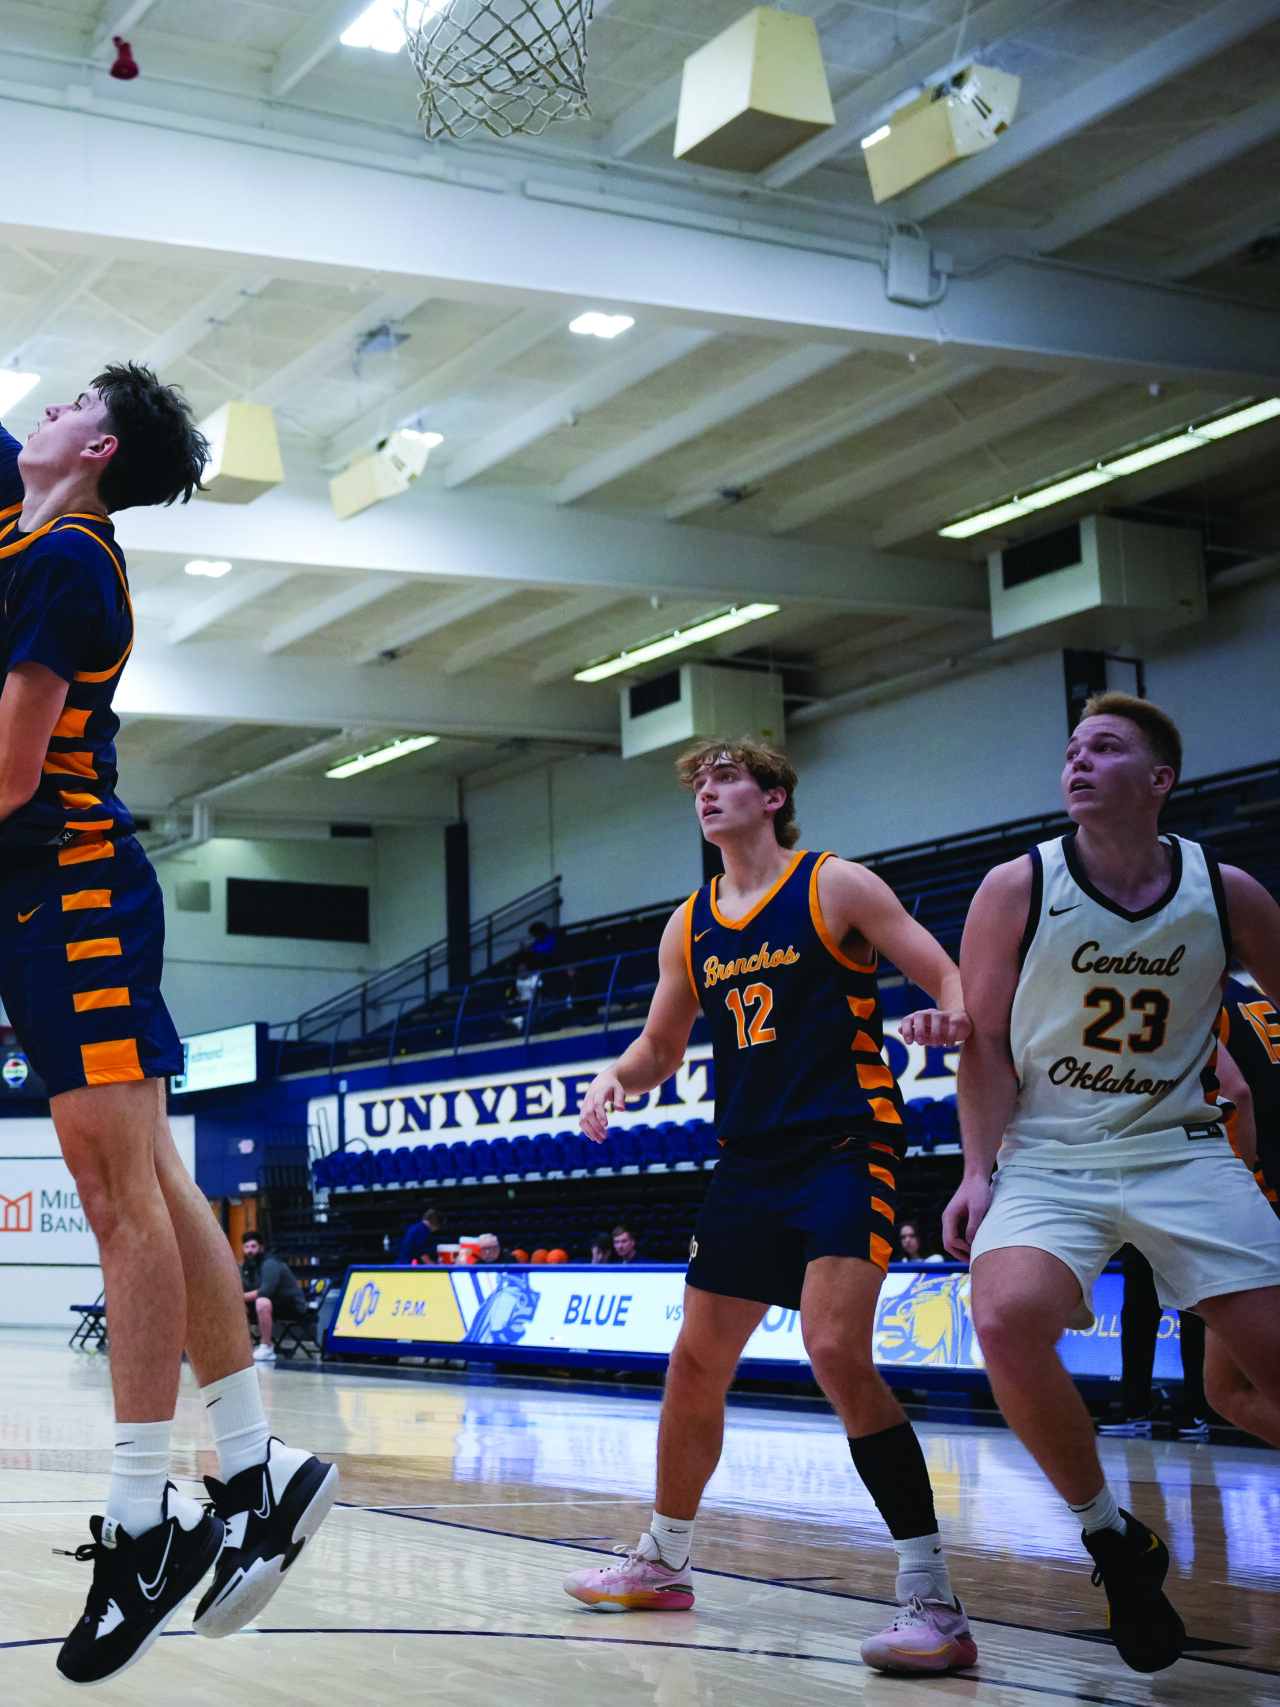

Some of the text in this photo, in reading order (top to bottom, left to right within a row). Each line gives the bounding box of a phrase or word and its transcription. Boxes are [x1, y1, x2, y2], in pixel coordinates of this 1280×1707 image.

[703, 941, 800, 988] Bronchos
[1071, 940, 1186, 976] Central
[725, 982, 777, 1050] 12
[1082, 986, 1171, 1055] 23
[1048, 1056, 1180, 1097] Oklahom
[392, 1299, 400, 1317] 3
[563, 1294, 633, 1327] BLUE
